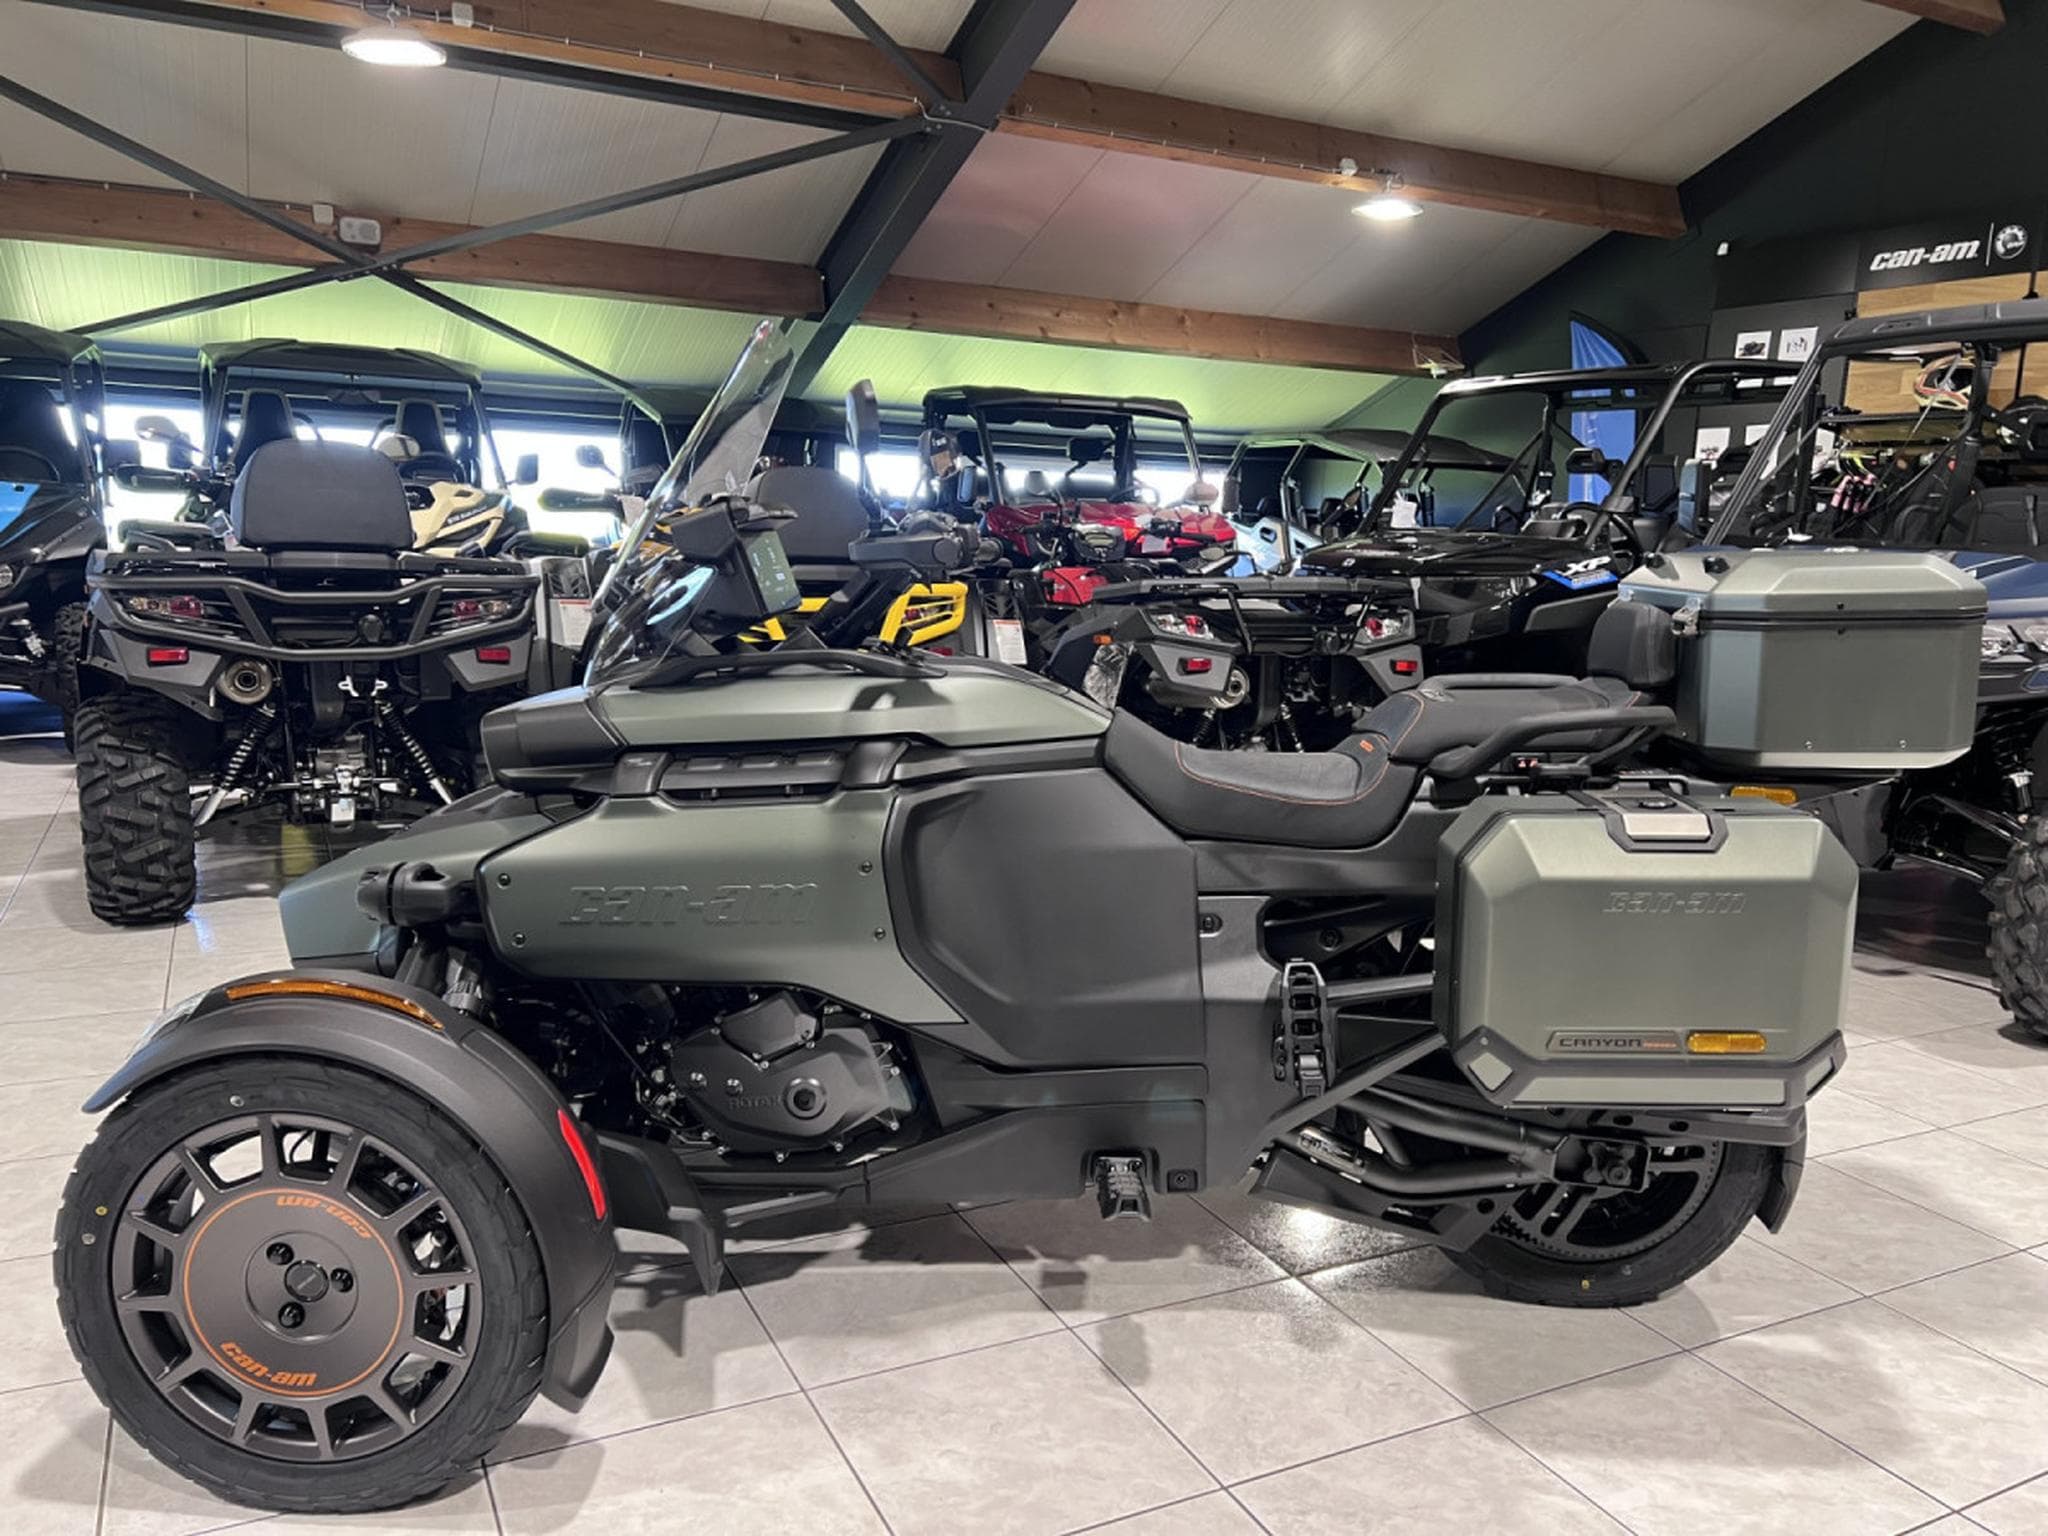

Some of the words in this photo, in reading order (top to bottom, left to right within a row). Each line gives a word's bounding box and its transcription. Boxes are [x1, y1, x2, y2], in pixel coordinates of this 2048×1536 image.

[1869, 239, 1981, 271] can-am
[558, 883, 819, 926] can-am
[1602, 891, 1746, 913] can-am
[1559, 1037, 1642, 1047] CANYON
[276, 1195, 373, 1238] can-am
[220, 1341, 318, 1386] can-am
